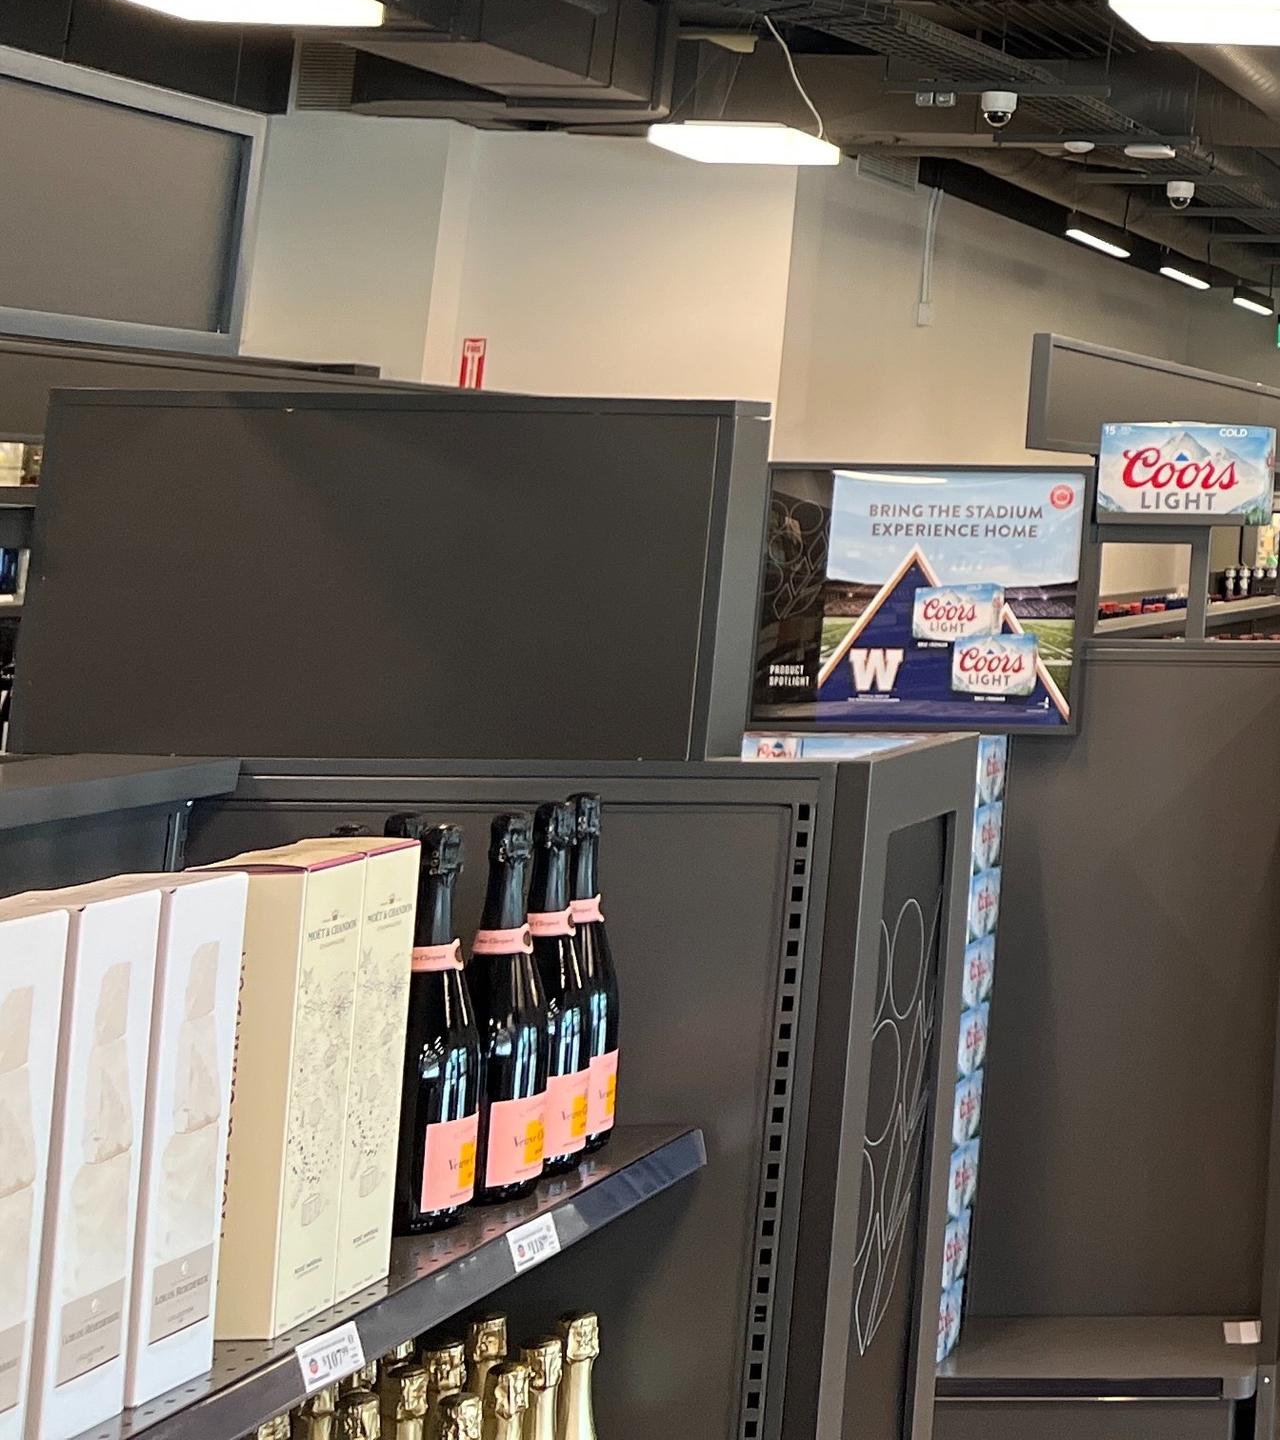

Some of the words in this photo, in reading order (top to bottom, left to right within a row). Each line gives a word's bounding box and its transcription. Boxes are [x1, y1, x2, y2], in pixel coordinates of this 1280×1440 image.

[1219, 428, 1248, 438] COLD
[1122, 447, 1239, 490] Coors
[1141, 491, 1217, 510] LIGHT
[869, 504, 925, 518] BRING
[928, 505, 961, 518] THE
[966, 505, 1043, 519] STADIUM
[871, 523, 979, 537] EXPERIENCE
[985, 524, 1038, 538] HOME
[923, 598, 977, 621] Coors
[930, 622, 966, 633] LIGHT
[959, 647, 1025, 673] Coors
[769, 664, 805, 675] PRODUCT
[850, 648, 904, 691] W
[769, 676, 810, 687] SPOTLIGHT
[968, 674, 1011, 686] LIGHT
